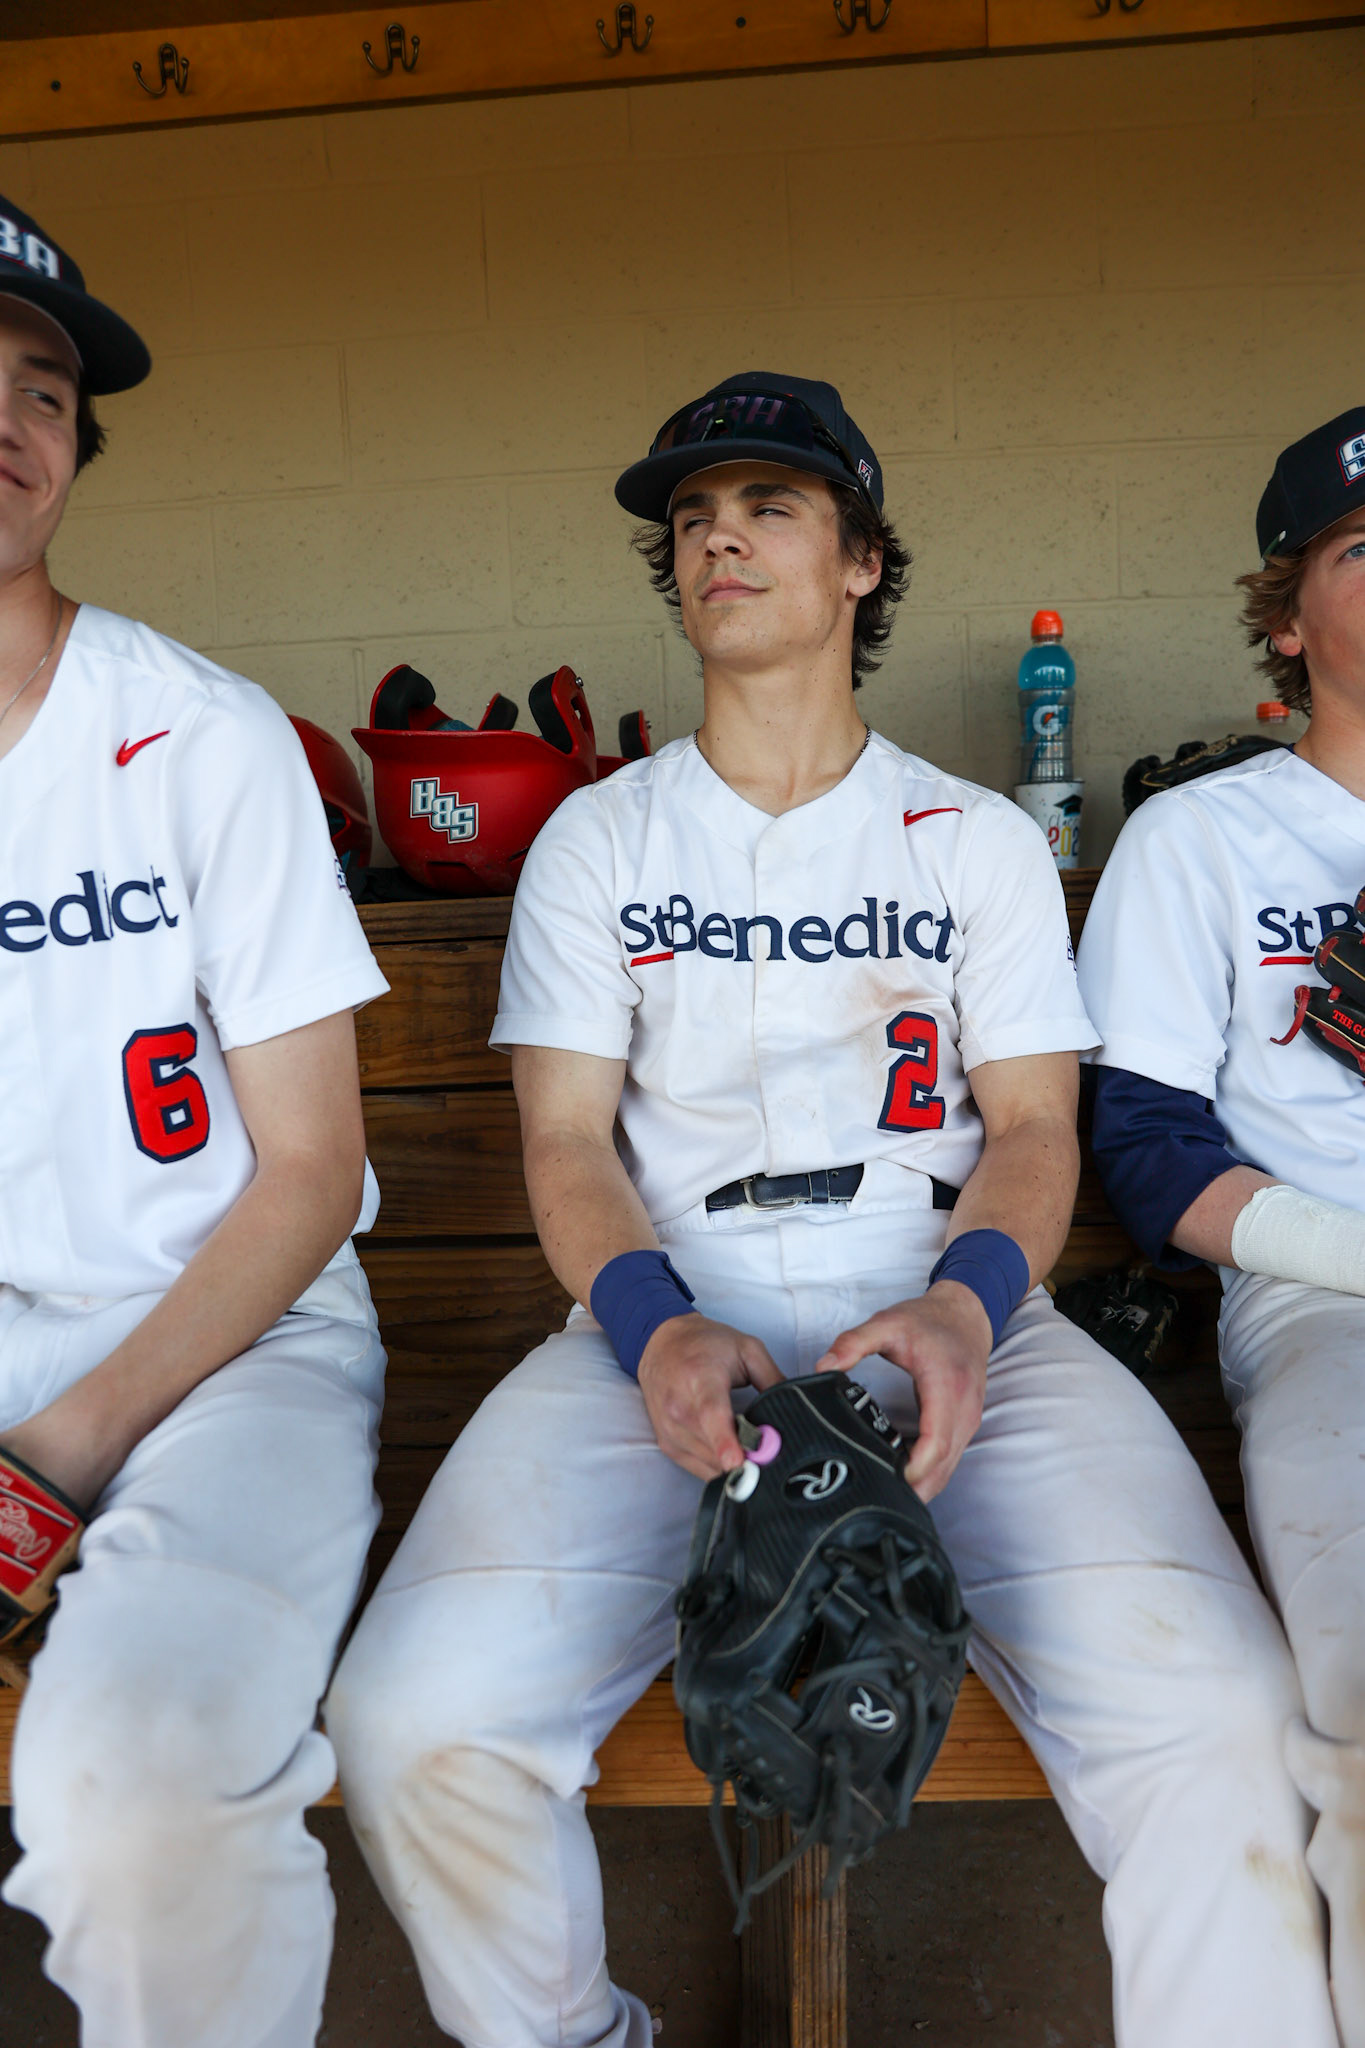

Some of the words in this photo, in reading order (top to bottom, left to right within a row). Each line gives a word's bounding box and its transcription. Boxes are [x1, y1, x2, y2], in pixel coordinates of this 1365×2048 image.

[1032, 704, 1060, 736] G
[1332, 1009, 1353, 1030] THE
[121, 1023, 211, 1165] 6
[877, 1010, 947, 1133] 2
